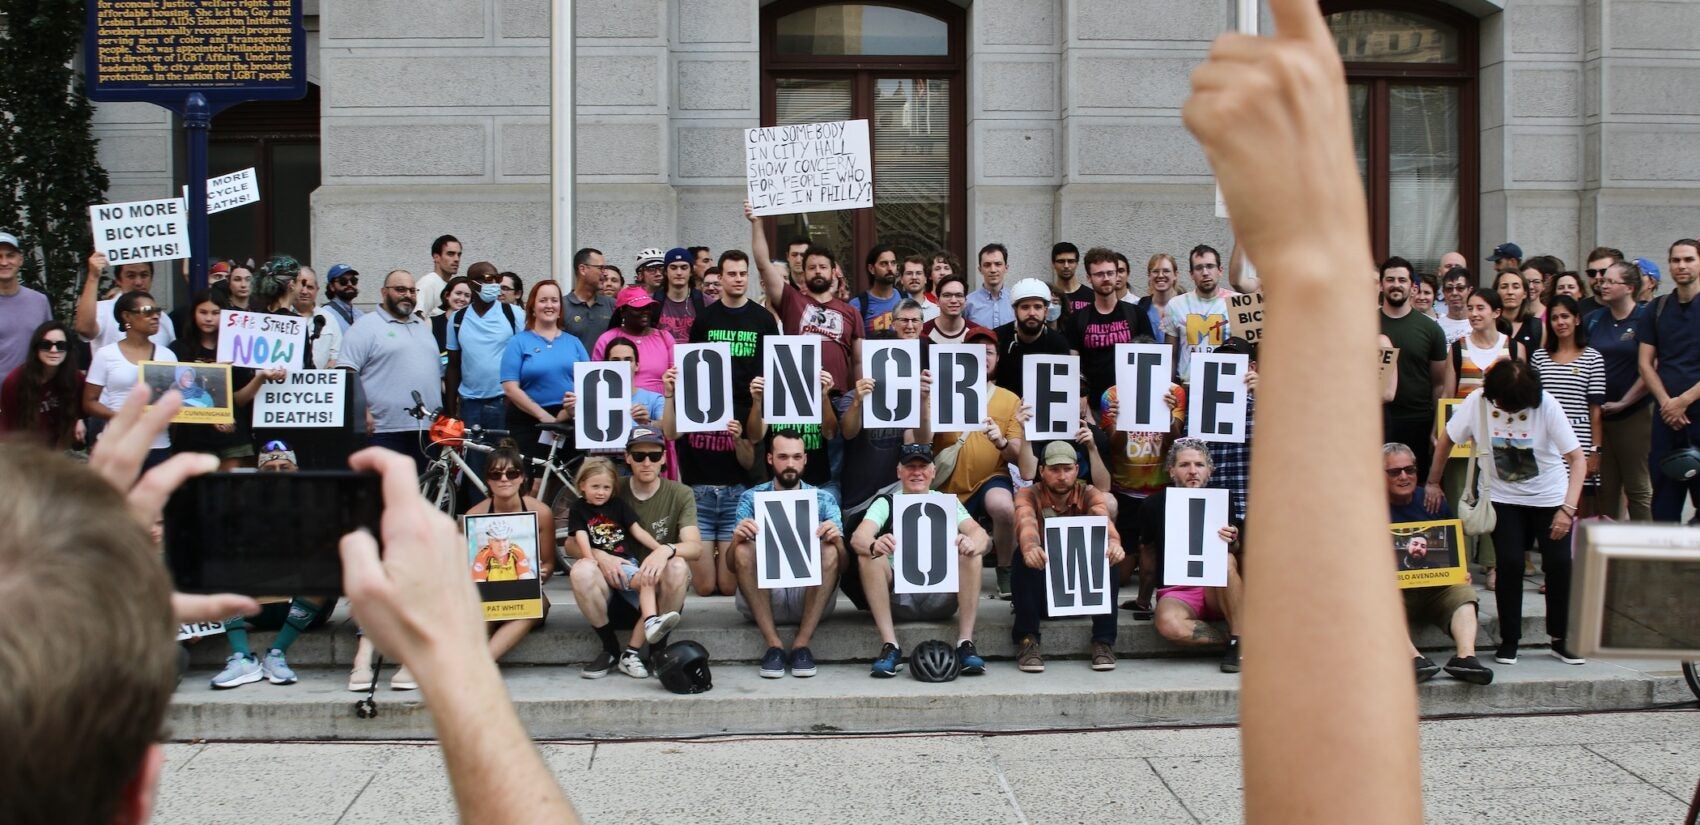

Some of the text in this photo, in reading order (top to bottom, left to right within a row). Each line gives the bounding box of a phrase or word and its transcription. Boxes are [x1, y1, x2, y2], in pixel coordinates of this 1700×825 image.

[114, 0, 159, 8] economic
[98, 9, 150, 18] affordable
[195, 8, 213, 16] She
[215, 8, 230, 16] led
[232, 8, 249, 16] the
[251, 8, 271, 17] Gay
[272, 8, 291, 16] and
[98, 18, 135, 26] Lesbian
[137, 18, 168, 26] Latino
[170, 17, 196, 26] AIDS
[198, 17, 244, 25] Education
[98, 26, 292, 37] developing nationally recognized programs
[98, 37, 134, 46] serving
[163, 36, 175, 44] of
[179, 35, 205, 44] color
[208, 35, 228, 44] and
[232, 34, 292, 44] transgender
[136, 45, 154, 53] She
[176, 44, 225, 54] appointed
[122, 54, 162, 62] director
[164, 54, 175, 62] of
[177, 53, 204, 62] LGBT
[245, 52, 274, 61] Under
[275, 52, 292, 60] her
[153, 63, 168, 71] the
[170, 63, 190, 72] city
[192, 62, 231, 72] adopted
[232, 62, 249, 70] the
[250, 62, 292, 70] broadest
[99, 71, 292, 83] protections in the nation for LGBT people.
[749, 122, 845, 143] CAN SOMEBODY
[749, 138, 855, 160] IN CITY HALL
[750, 156, 856, 178] SHOW CONCERN
[213, 171, 250, 186] MORE
[750, 169, 864, 192] FOR PEOPLE WHO
[207, 183, 248, 199] CYCLE
[752, 182, 872, 209] LIVE IN PHILLY?
[207, 194, 251, 211] EATHS!
[99, 202, 177, 221] NO MORE
[106, 223, 176, 241] BICYCLE
[108, 243, 179, 261] DEATHS!
[1231, 295, 1252, 307] NO
[228, 314, 300, 335] SAFE STREETS
[708, 330, 758, 343] PHILLY BIKE
[233, 334, 294, 365] NOW
[292, 373, 337, 384] MORE
[265, 392, 333, 403] BICYCLE
[264, 412, 333, 423] DEATHS!
[1126, 440, 1163, 458] DAY
[1412, 571, 1450, 579] AVENDANO
